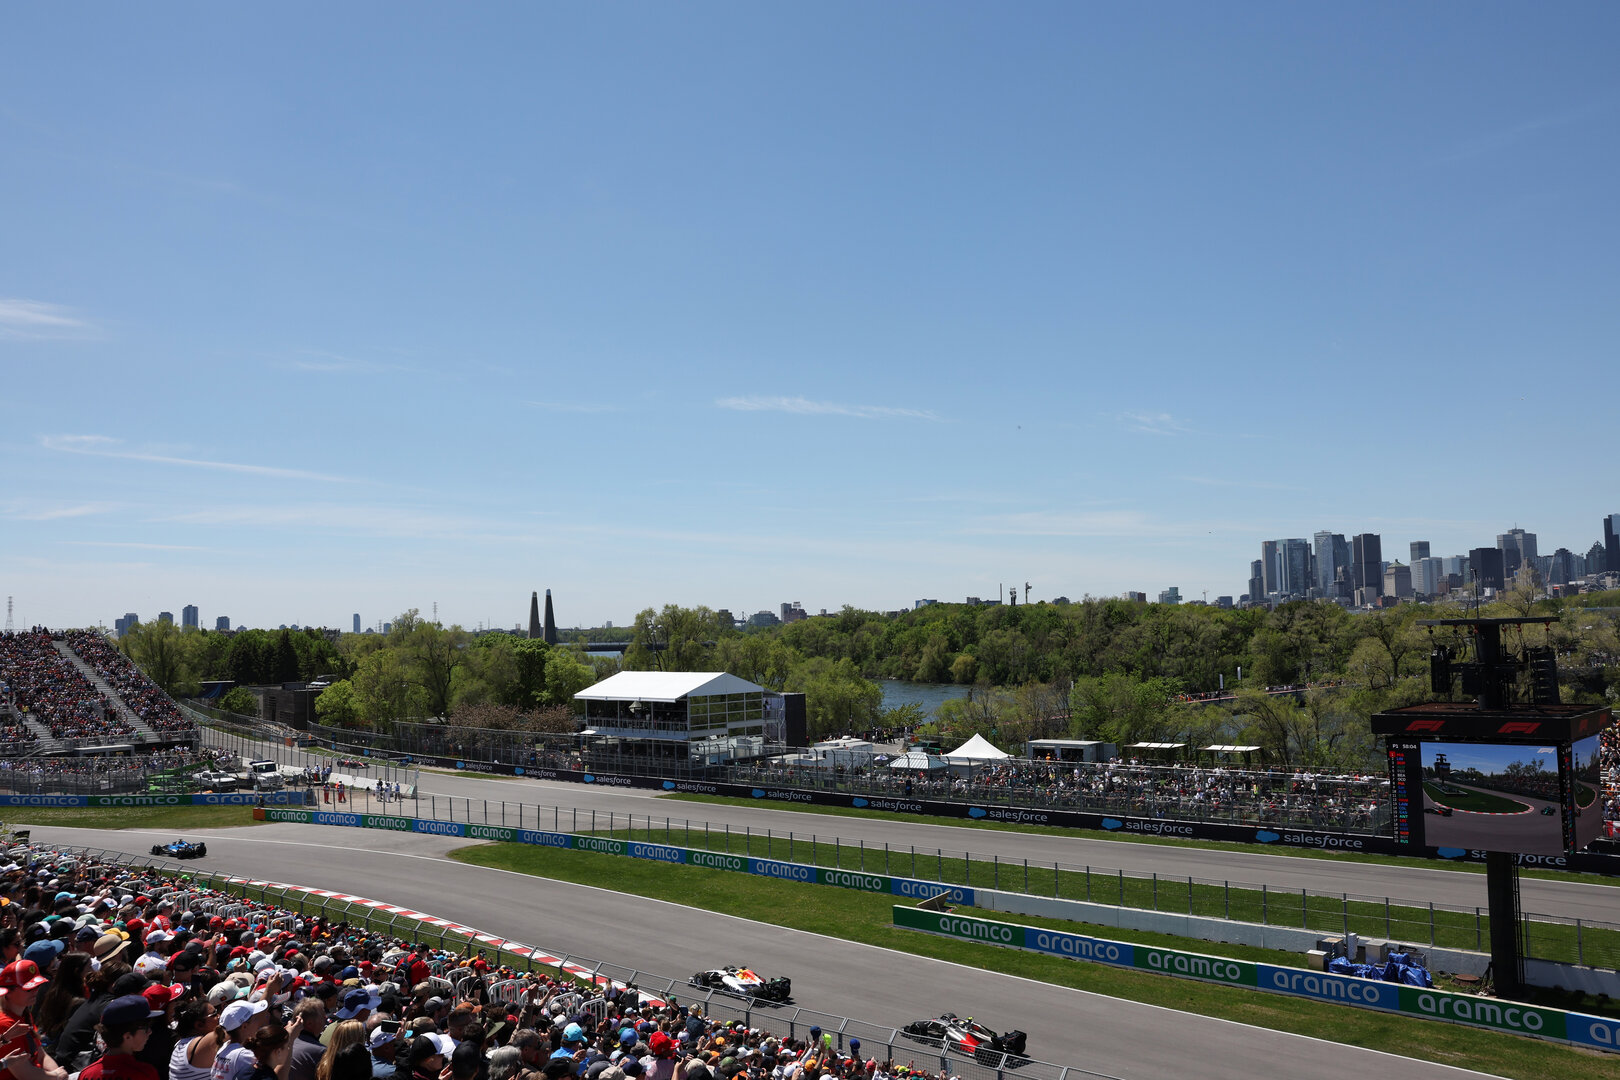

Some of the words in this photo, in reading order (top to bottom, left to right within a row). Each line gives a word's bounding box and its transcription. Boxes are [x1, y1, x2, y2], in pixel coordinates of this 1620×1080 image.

[466, 763, 493, 772] salesforce
[525, 768, 557, 779] salesforce
[596, 775, 632, 786] salesforce
[675, 780, 716, 793] salesforce
[9, 795, 80, 804] aramco
[99, 796, 179, 804] aramco
[767, 790, 812, 802] salesforce
[871, 799, 922, 812] salesforce
[270, 811, 308, 821] aramco
[318, 813, 356, 825] aramco
[989, 810, 1048, 822] salesforce
[369, 818, 407, 829] aramco
[418, 821, 458, 834] aramco
[1126, 819, 1195, 834] salesforce
[470, 826, 511, 838] aramco
[523, 832, 566, 846] aramco
[1284, 832, 1365, 849] salesforce
[577, 838, 621, 854] aramco
[632, 843, 679, 860] aramco
[692, 852, 741, 870] aramco
[1471, 850, 1567, 866] saforce
[756, 860, 808, 879] aramco
[824, 870, 881, 889] aramco
[939, 917, 1012, 942] aramco
[1037, 934, 1119, 961] aramco
[1147, 951, 1240, 980] aramco
[1272, 971, 1380, 1002] aramco
[1417, 994, 1543, 1030] aramco
